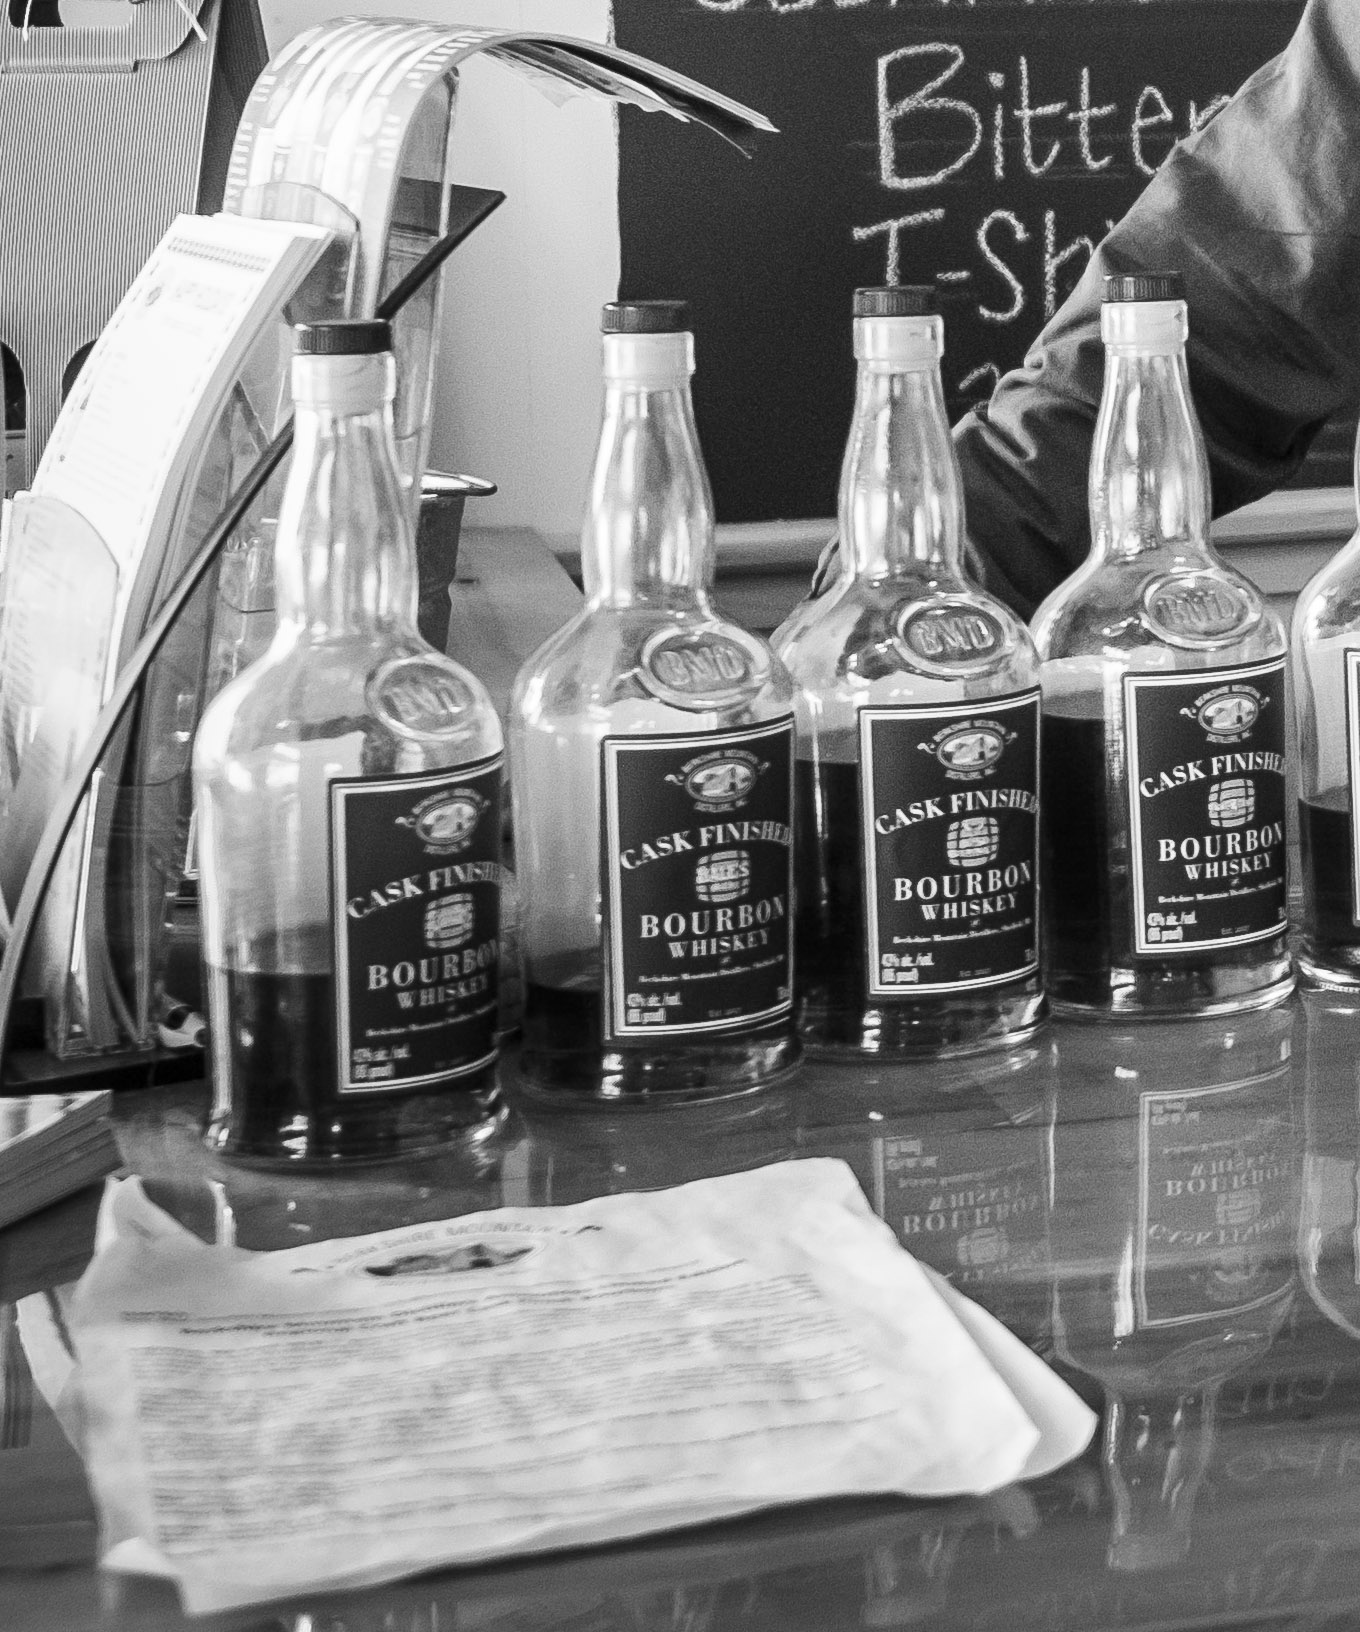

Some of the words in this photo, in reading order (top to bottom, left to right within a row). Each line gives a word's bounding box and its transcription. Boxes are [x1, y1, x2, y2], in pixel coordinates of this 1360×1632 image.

[1139, 760, 1206, 799] CASK
[874, 795, 946, 835] CASK
[619, 830, 694, 870] CASK
[1158, 820, 1284, 863] BOURBON
[893, 861, 1033, 902] BOURBON
[1185, 850, 1273, 882] WHISKEY
[347, 874, 422, 918] CASK
[920, 890, 1017, 922] WHISKEY
[640, 894, 786, 939] BOURBON
[668, 927, 771, 959] WHISKEY
[397, 974, 488, 1009] WHISKEY
